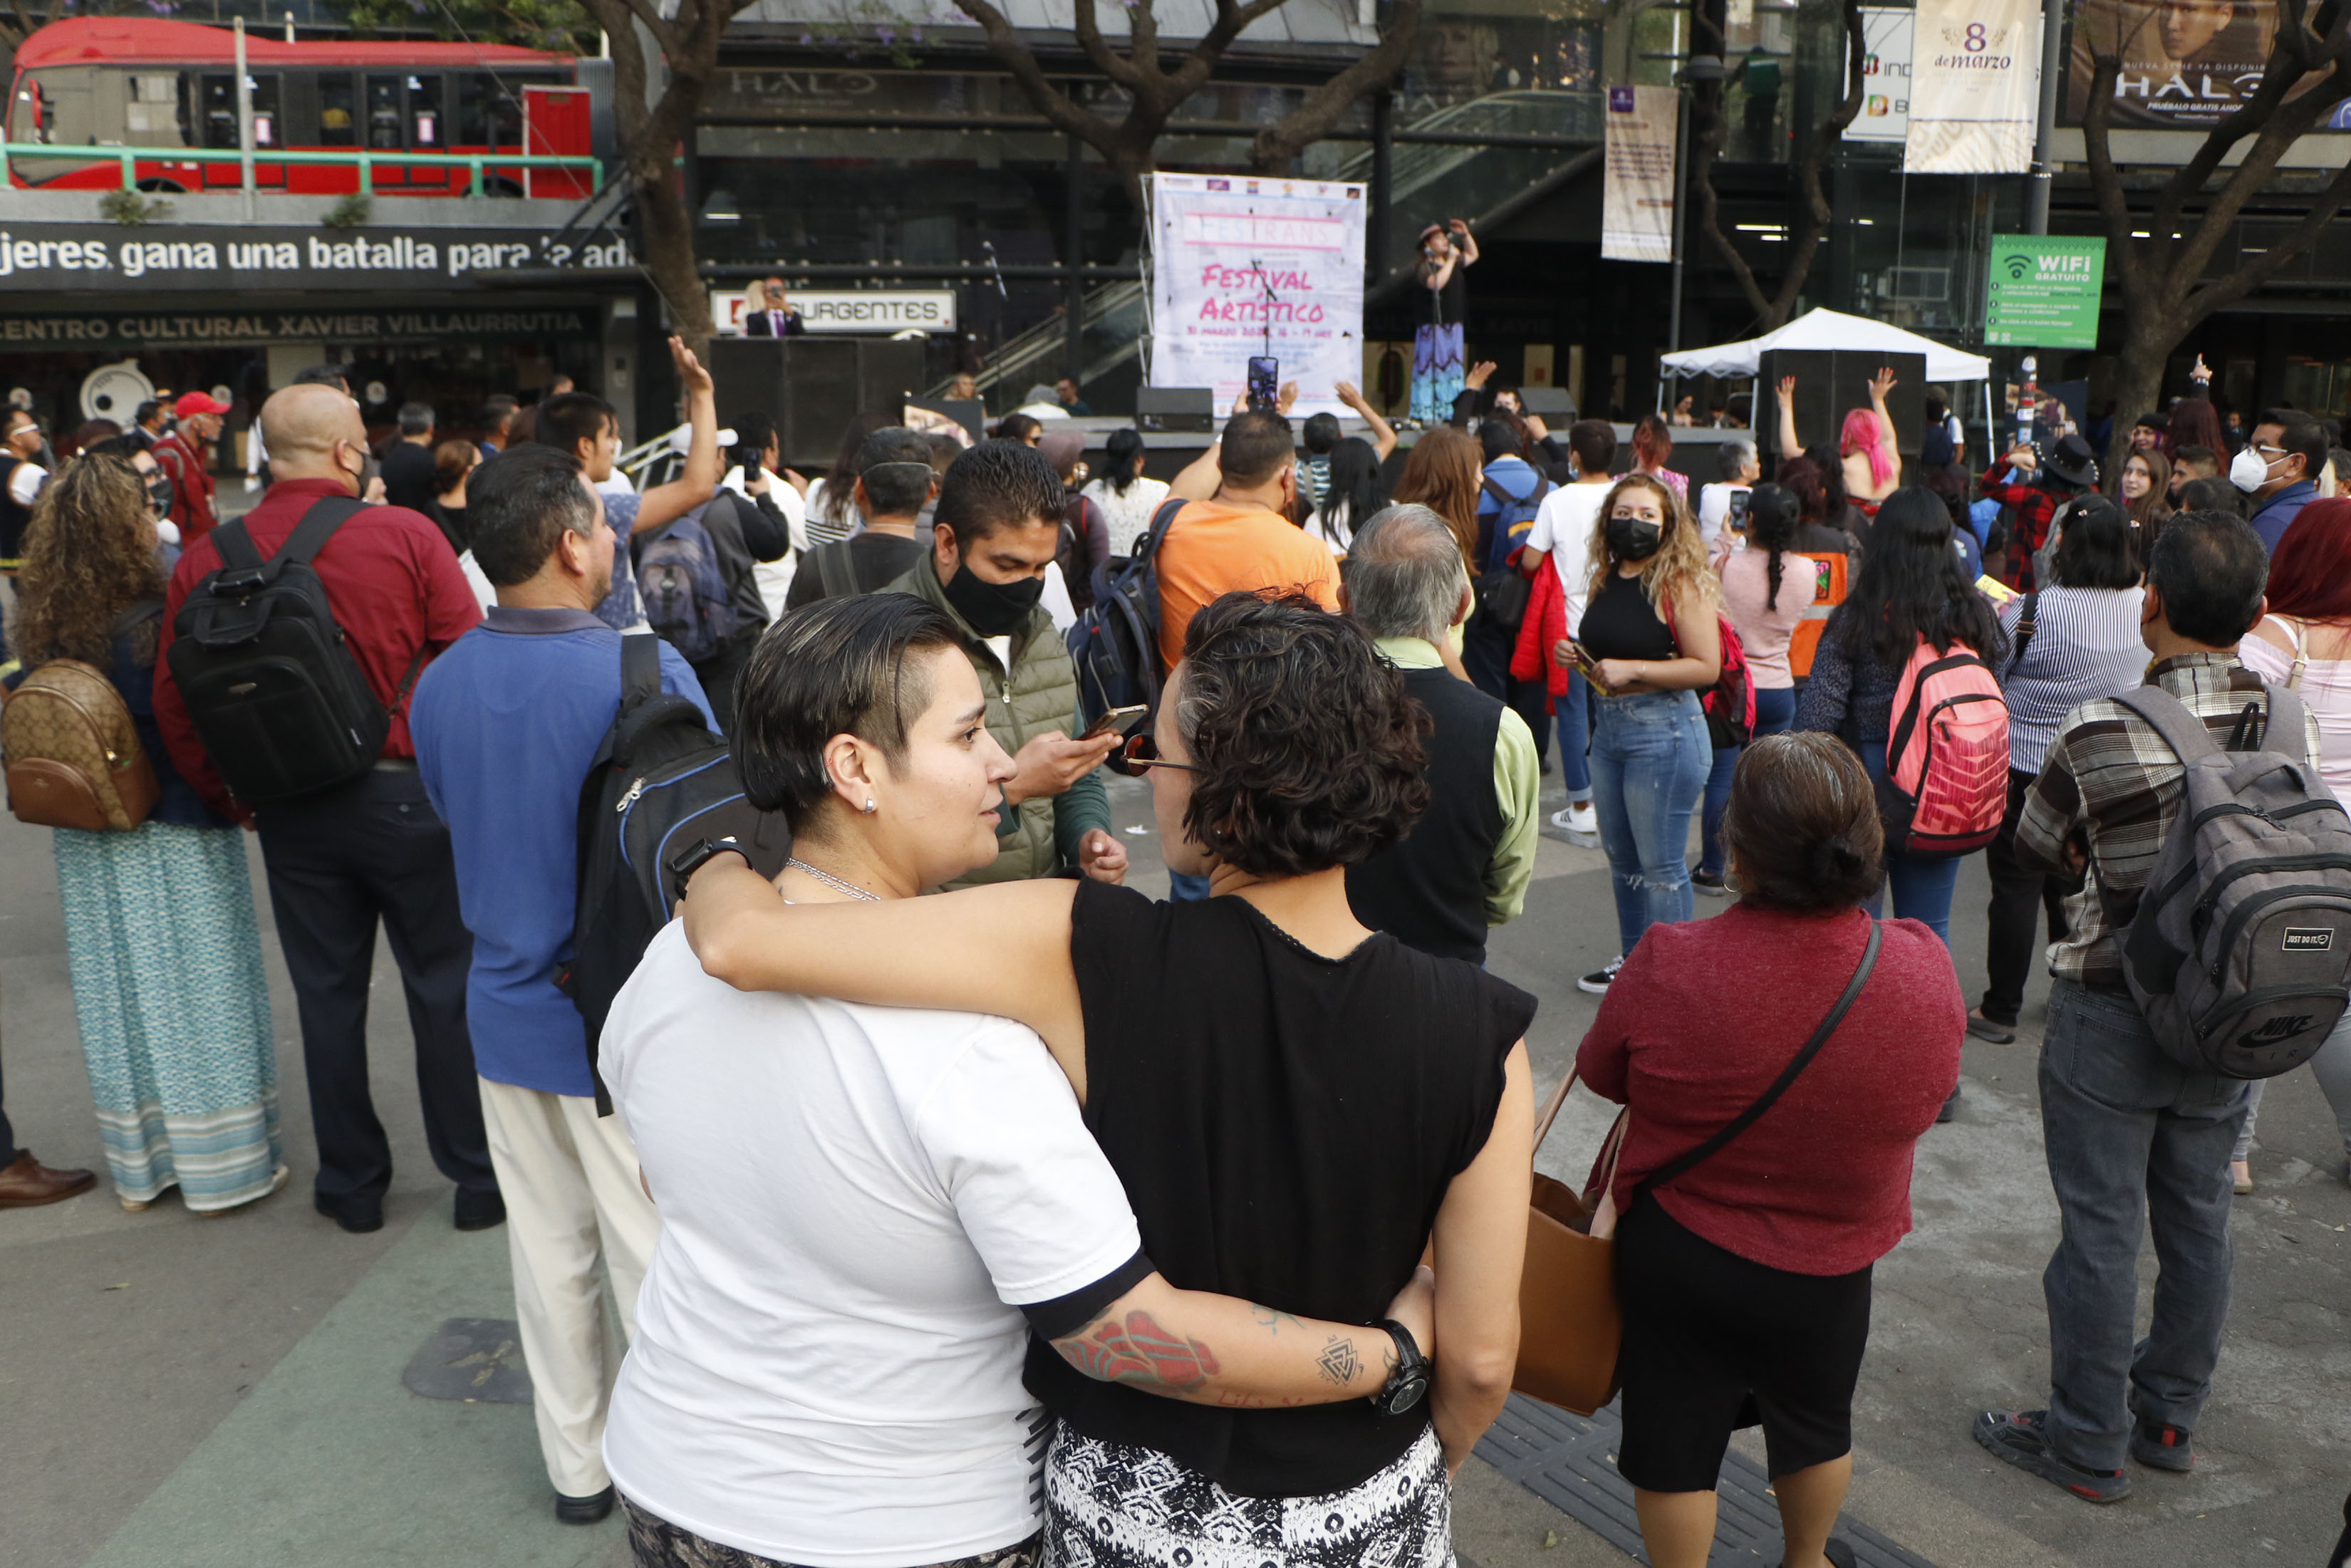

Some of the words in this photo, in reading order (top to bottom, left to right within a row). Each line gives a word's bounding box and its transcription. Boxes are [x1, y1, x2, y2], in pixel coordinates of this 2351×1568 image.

[1964, 22, 1986, 53] 8
[1935, 55, 1949, 67] de
[1951, 55, 2011, 69] marzo
[120, 242, 218, 277] gana
[227, 242, 299, 270] una
[309, 235, 438, 270] batalla
[448, 243, 531, 277] para
[1202, 264, 1313, 291] FESTIVAL
[2035, 272, 2090, 282] GRATUITO
[1200, 291, 1324, 323] ARTÍSTICO
[0, 319, 109, 340] ENTRO
[118, 318, 271, 338] CULTURAL
[279, 316, 380, 336] XAVIER
[387, 313, 583, 335] VILLAURRUTIA
[2287, 935, 2302, 944] JUST
[2302, 935, 2310, 944] DO
[2254, 1014, 2314, 1037] NIKE
